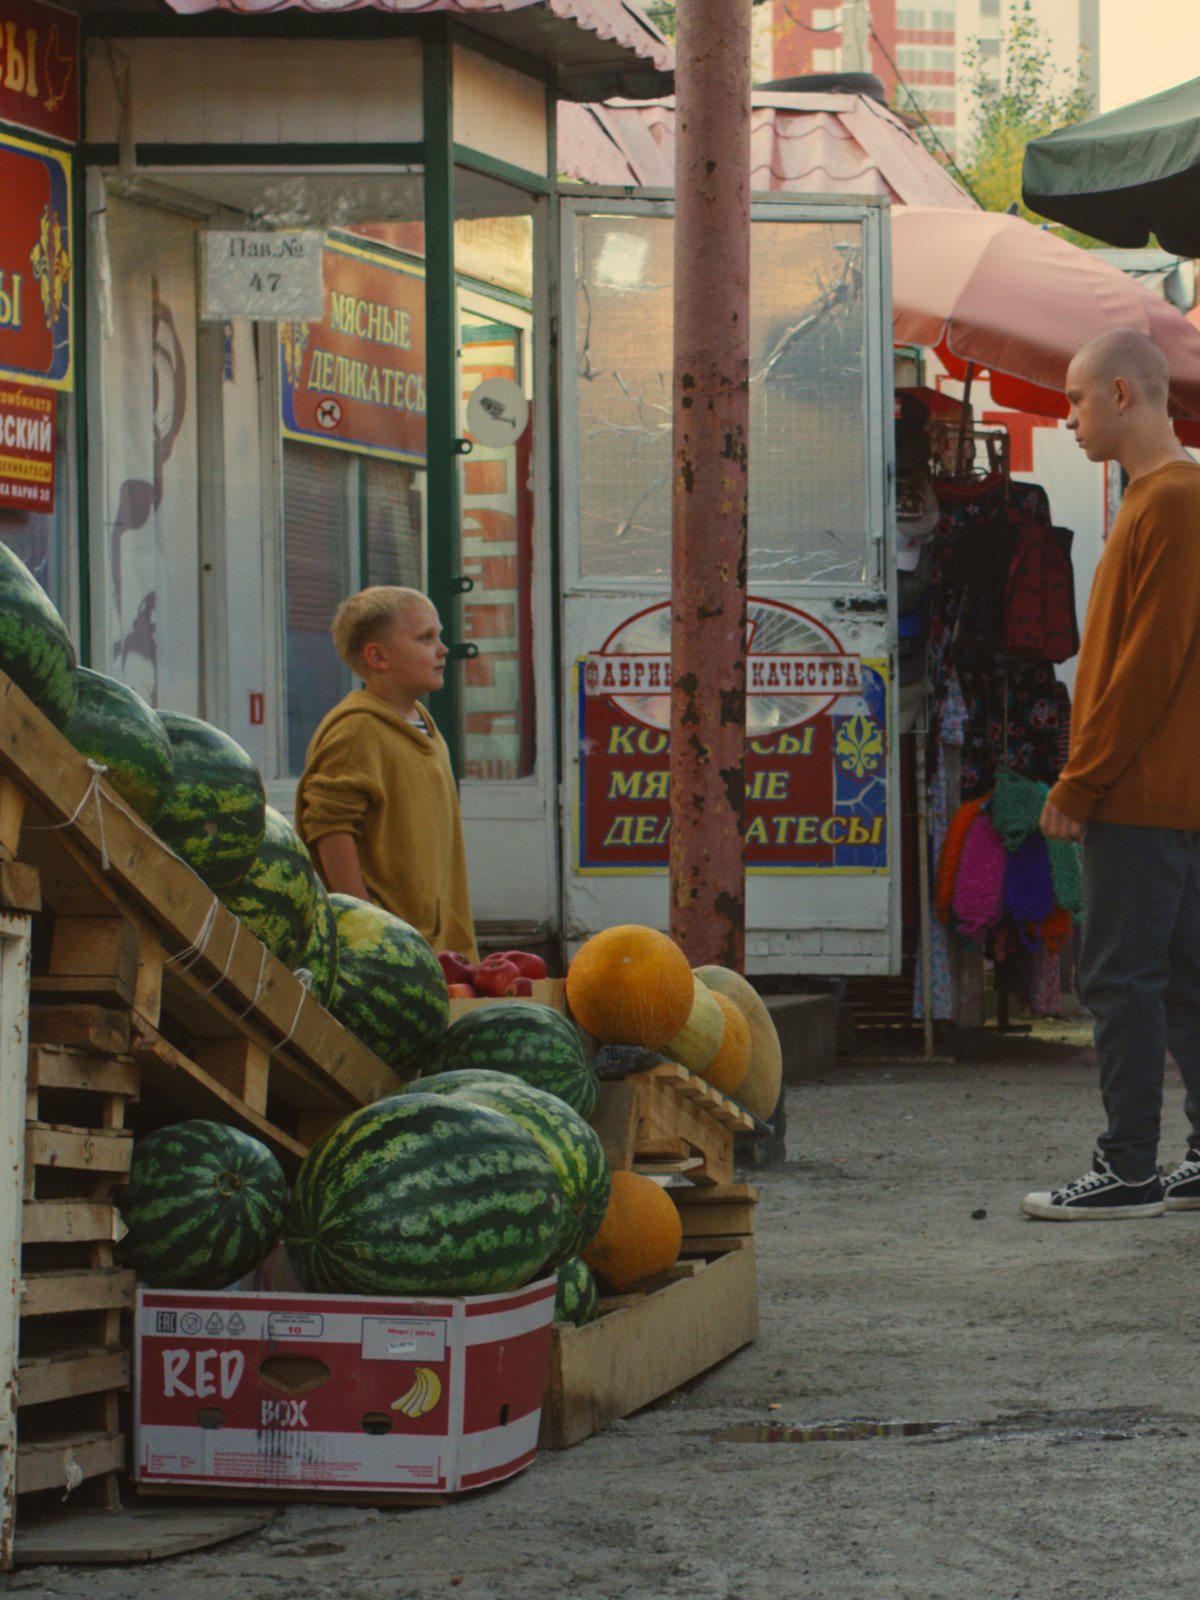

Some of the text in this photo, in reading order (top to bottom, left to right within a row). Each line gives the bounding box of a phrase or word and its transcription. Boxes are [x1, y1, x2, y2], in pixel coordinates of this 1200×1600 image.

[0, 20, 38, 98] Ы
[250, 273, 281, 293] 47
[331, 290, 411, 349] МЯСНЫЕ
[752, 662, 858, 687] КАЧЕСТВА
[603, 816, 883, 846] ДЕАТЕСЫ
[287, 1326, 303, 1335] 10
[162, 1348, 245, 1399] RED
[261, 1400, 309, 1428] BOX
